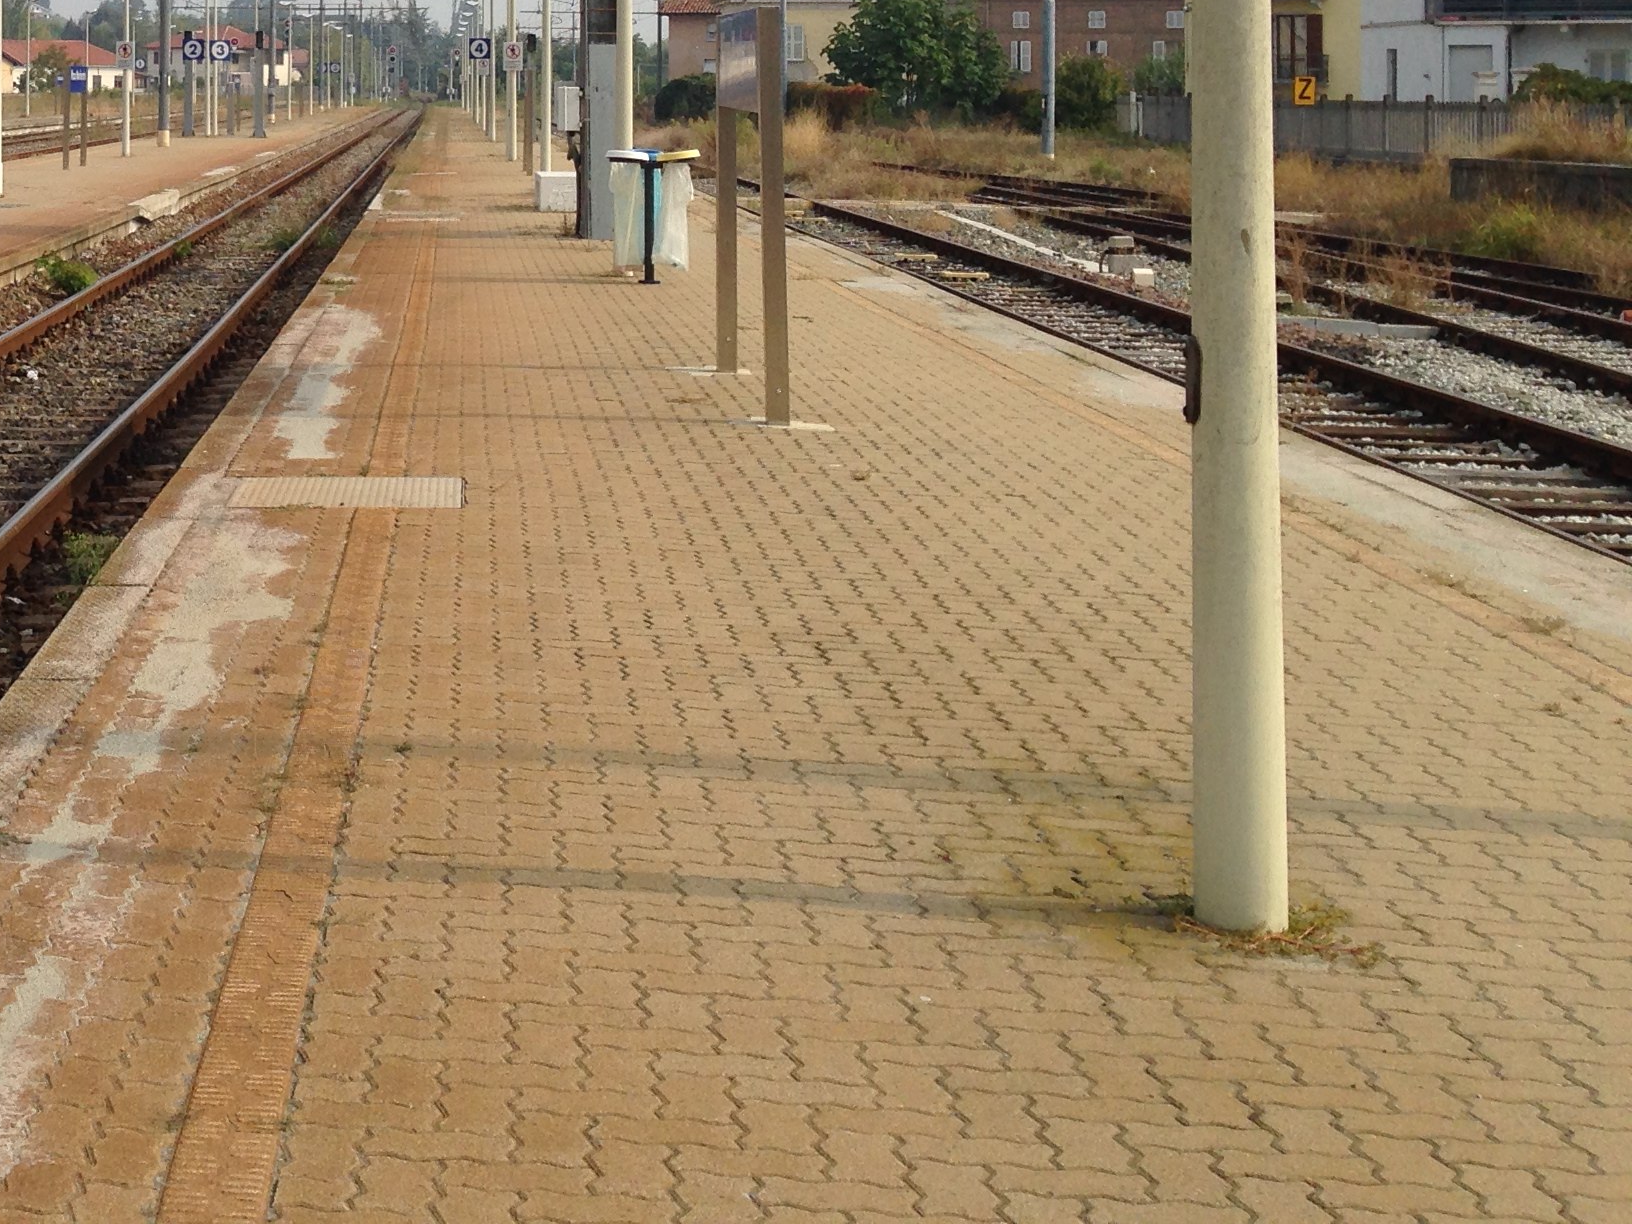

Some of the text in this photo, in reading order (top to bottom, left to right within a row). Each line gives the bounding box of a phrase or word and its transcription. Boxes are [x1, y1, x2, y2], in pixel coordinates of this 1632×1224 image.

[188, 43, 198, 55] 2
[216, 44, 225, 56] 3
[474, 43, 484, 55] 4
[1298, 78, 1312, 100] Z
